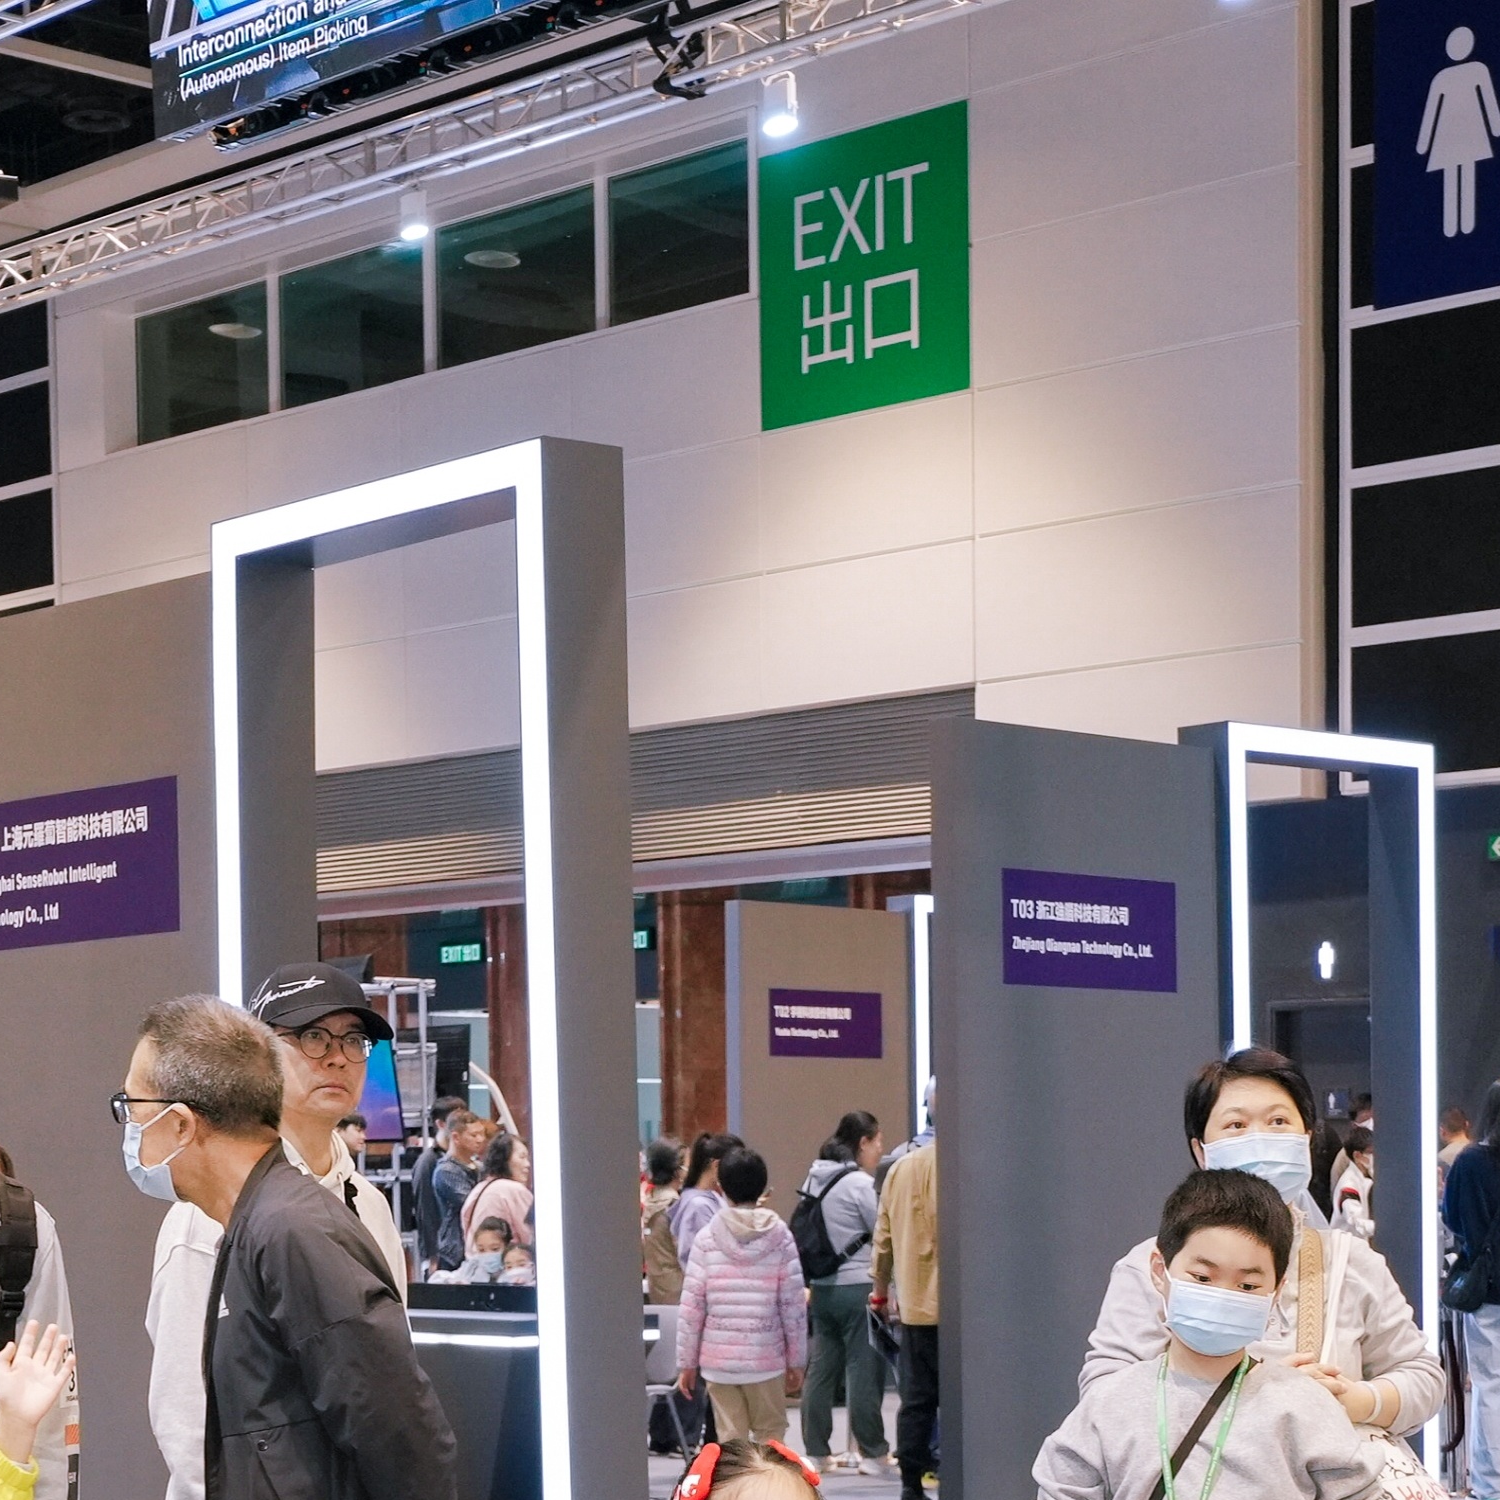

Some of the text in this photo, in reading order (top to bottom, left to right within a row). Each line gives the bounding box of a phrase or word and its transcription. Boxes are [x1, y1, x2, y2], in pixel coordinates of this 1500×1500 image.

[178, 2, 308, 67] Interconnection
[180, 15, 368, 102] (Autonomous) Item Picking
[794, 161, 929, 271] EXIT
[801, 268, 919, 374] 出口
[16, 867, 68, 891] SenseRobot
[69, 861, 118, 884] Intelligent
[25, 905, 43, 925] Co.,
[44, 902, 59, 921] Ltd
[1010, 899, 1035, 919] T03
[441, 946, 462, 964] EXIT
[1012, 936, 1045, 954] Zhejiang
[1081, 940, 1123, 959] Technology
